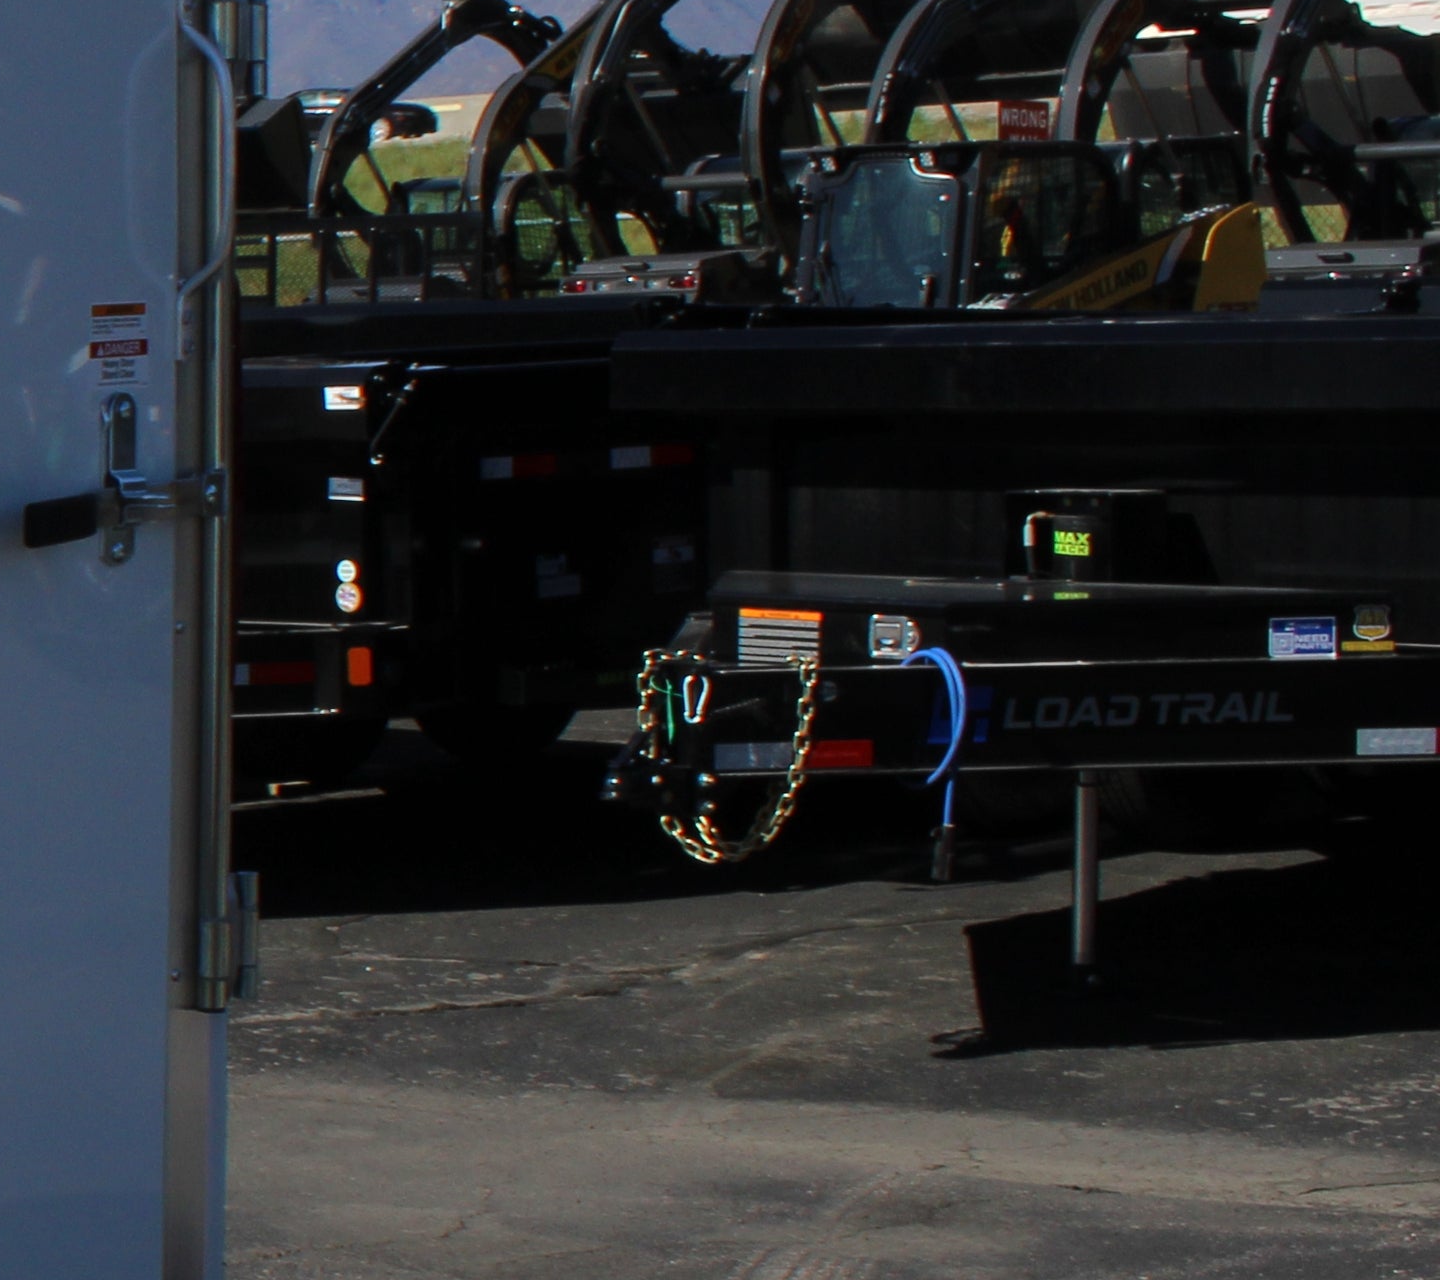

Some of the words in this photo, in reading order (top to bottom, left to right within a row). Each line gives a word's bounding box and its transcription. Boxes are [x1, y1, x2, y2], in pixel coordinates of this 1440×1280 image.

[1002, 109, 1047, 129] WRONG
[1076, 259, 1148, 303] HOLLAND
[104, 340, 141, 356] DANGER
[1054, 530, 1089, 545] MAX
[1055, 545, 1087, 554] JACK
[1294, 633, 1329, 643] NEED
[1002, 693, 1142, 730] LOAD
[1149, 690, 1296, 727] TRAIL
